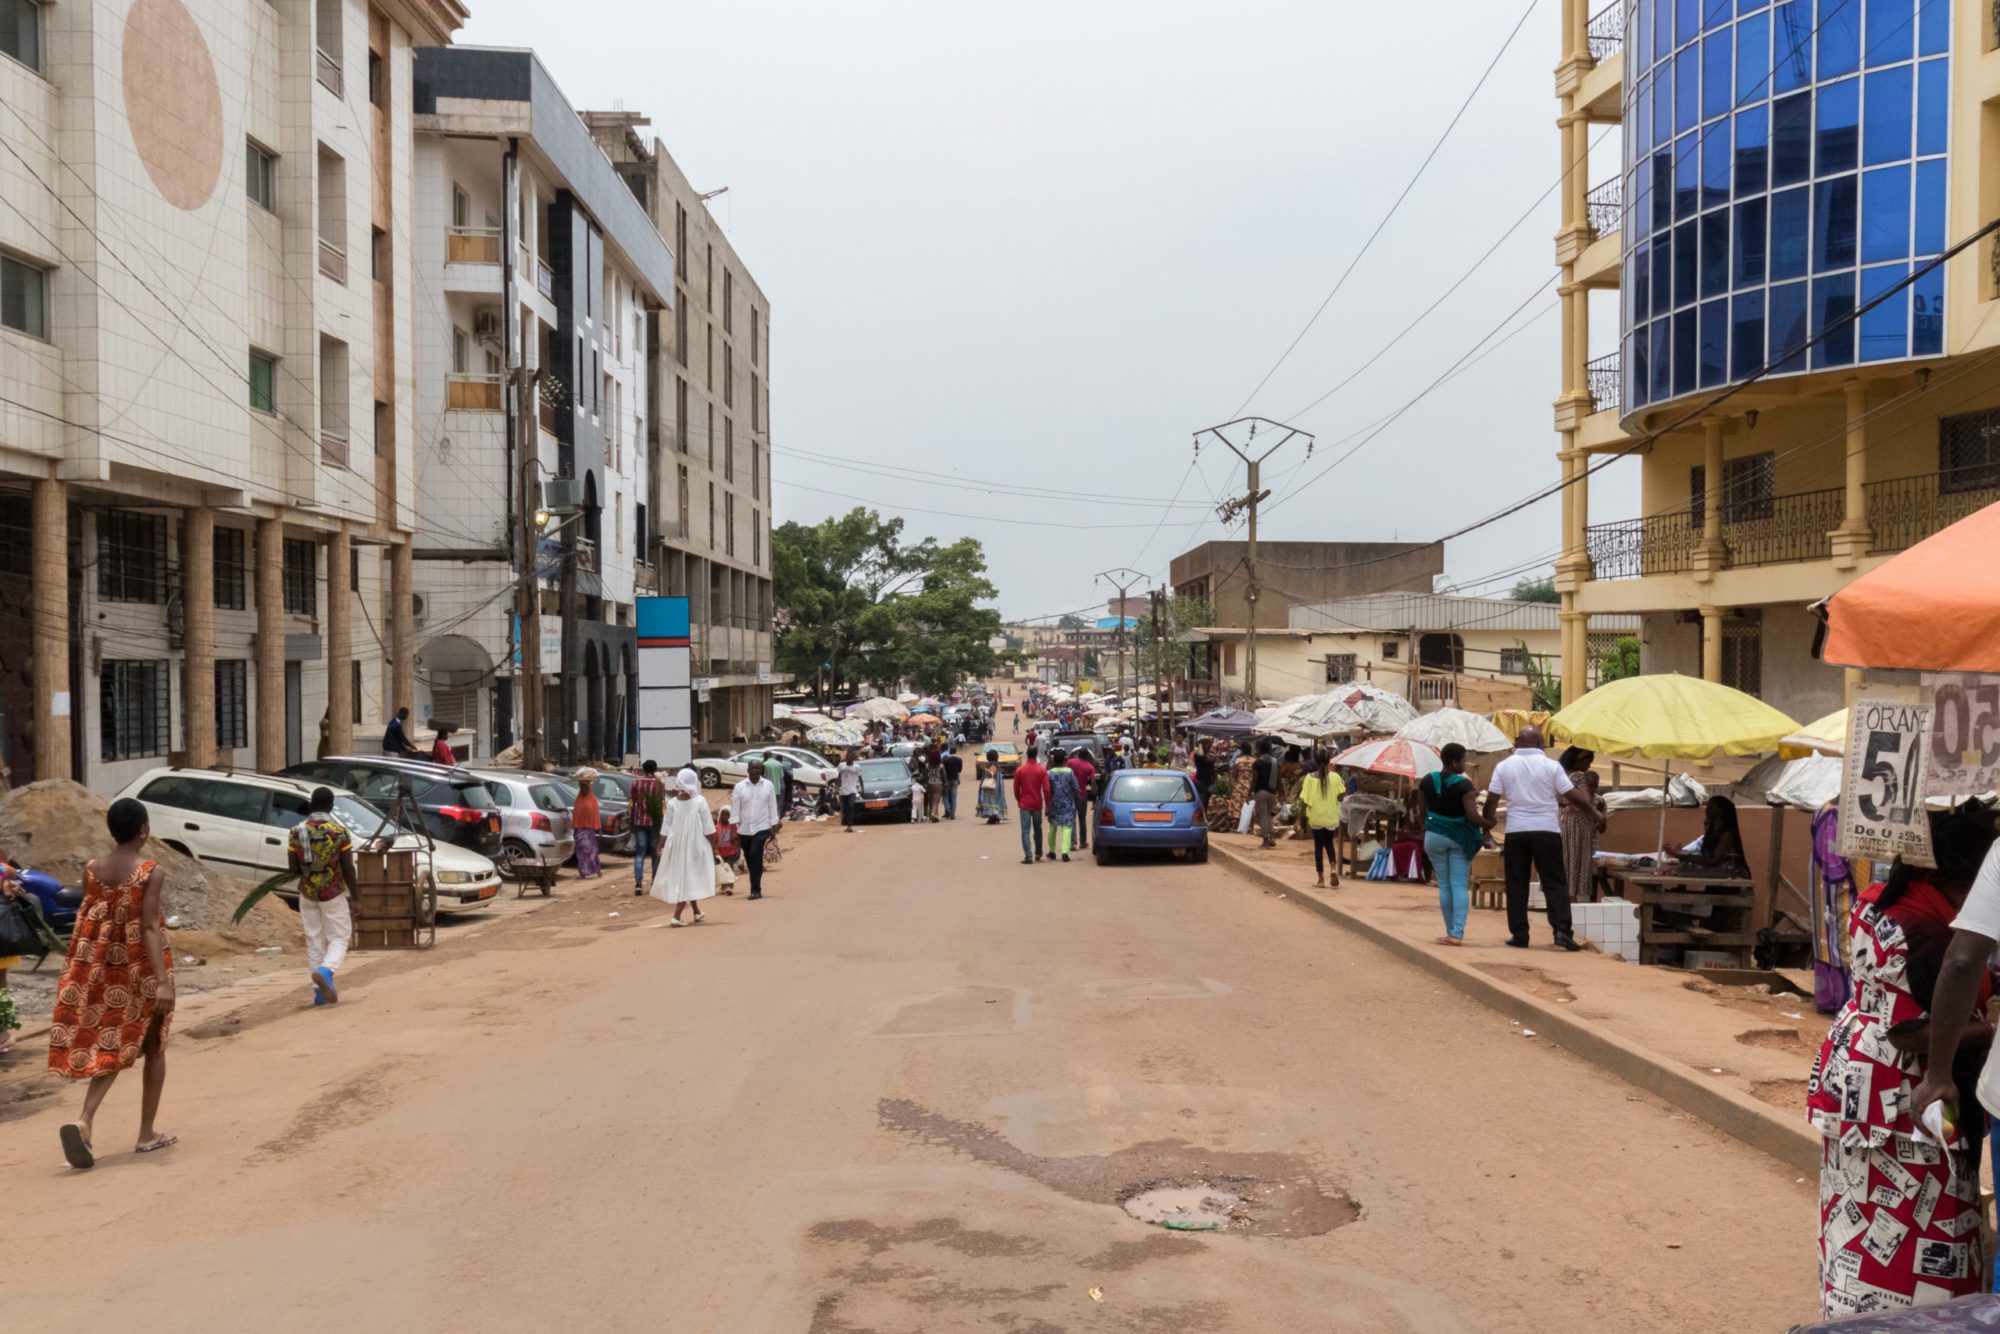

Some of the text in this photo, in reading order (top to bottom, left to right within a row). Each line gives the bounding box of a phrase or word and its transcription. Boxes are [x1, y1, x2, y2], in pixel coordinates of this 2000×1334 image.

[1855, 825, 1876, 836] De
[1878, 1164, 1898, 1182] TCHAD
[1876, 1186, 1902, 1198] CINEMA
